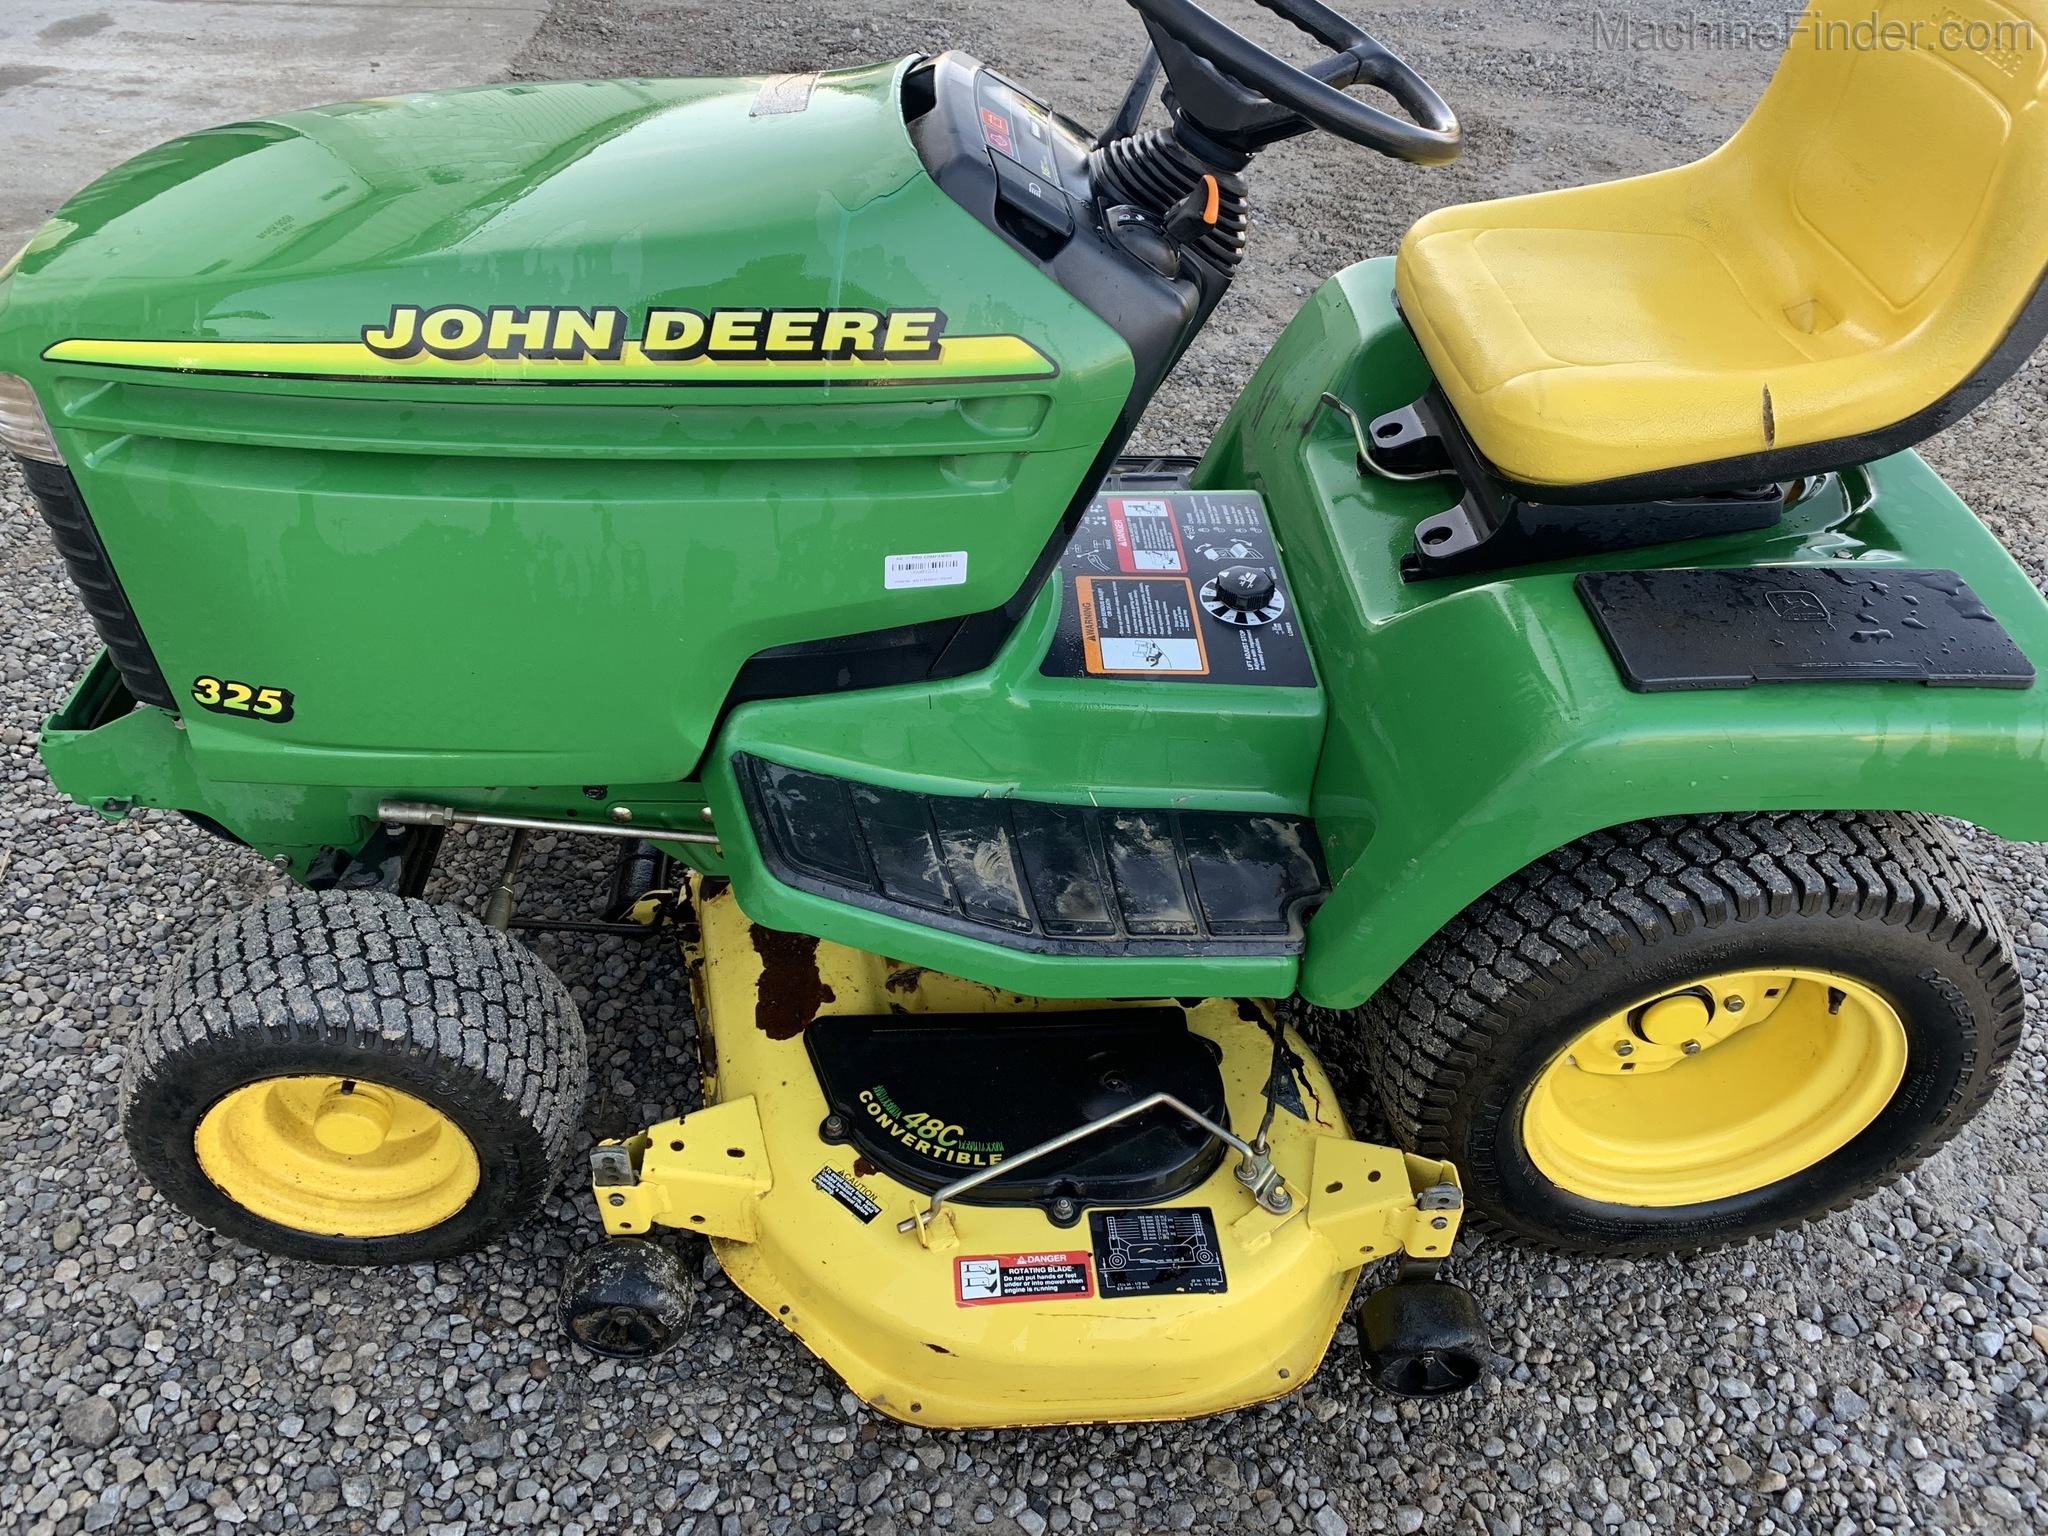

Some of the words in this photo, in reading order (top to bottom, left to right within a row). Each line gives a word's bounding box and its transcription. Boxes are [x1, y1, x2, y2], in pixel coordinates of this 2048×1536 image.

[364, 307, 625, 358] JOHN
[643, 309, 945, 358] DEERE
[1114, 519, 1126, 543] DANGER
[1082, 602, 1095, 635] WARNING
[1239, 630, 1248, 641] STOP
[1242, 642, 1252, 660] ADJUST
[1246, 660, 1254, 670] LIFT
[192, 677, 288, 718] 325
[1916, 967, 1978, 1039] MULTI
[859, 1090, 1003, 1166] CONVERTIBLE
[902, 1112, 964, 1147] 48C
[842, 1172, 879, 1201] CAUTION
[1009, 1267, 1046, 1275] ROTATING
[1027, 1254, 1067, 1263] DANGER
